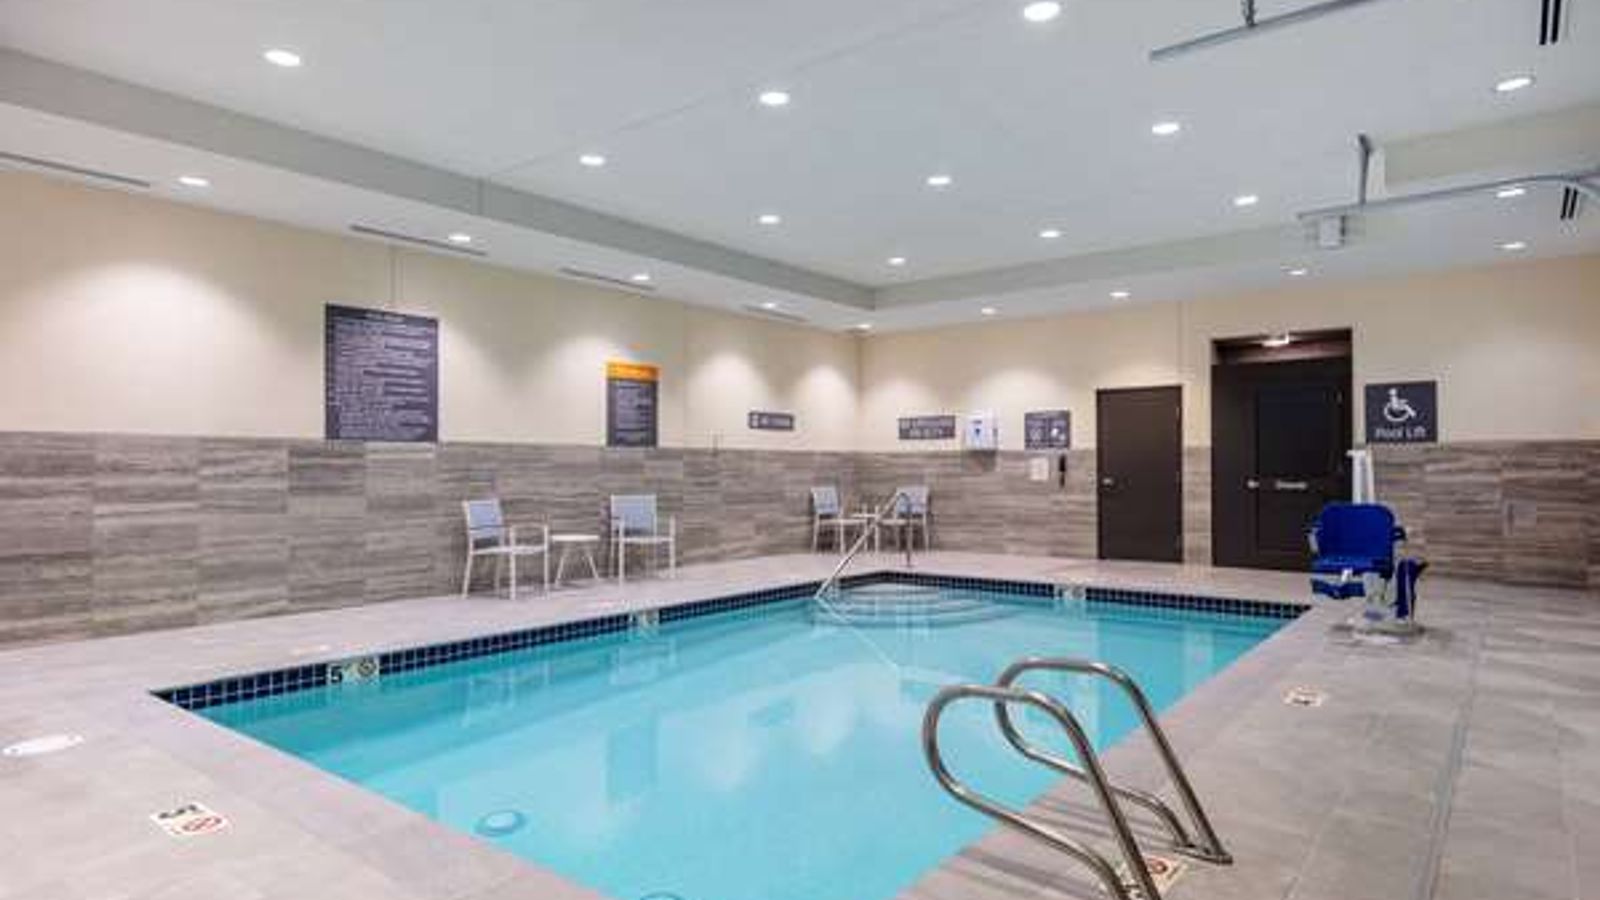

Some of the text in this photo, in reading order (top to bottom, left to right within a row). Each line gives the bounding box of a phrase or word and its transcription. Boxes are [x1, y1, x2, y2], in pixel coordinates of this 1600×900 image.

[1375, 425, 1427, 438] Pool Lift
[330, 665, 343, 683] 5
